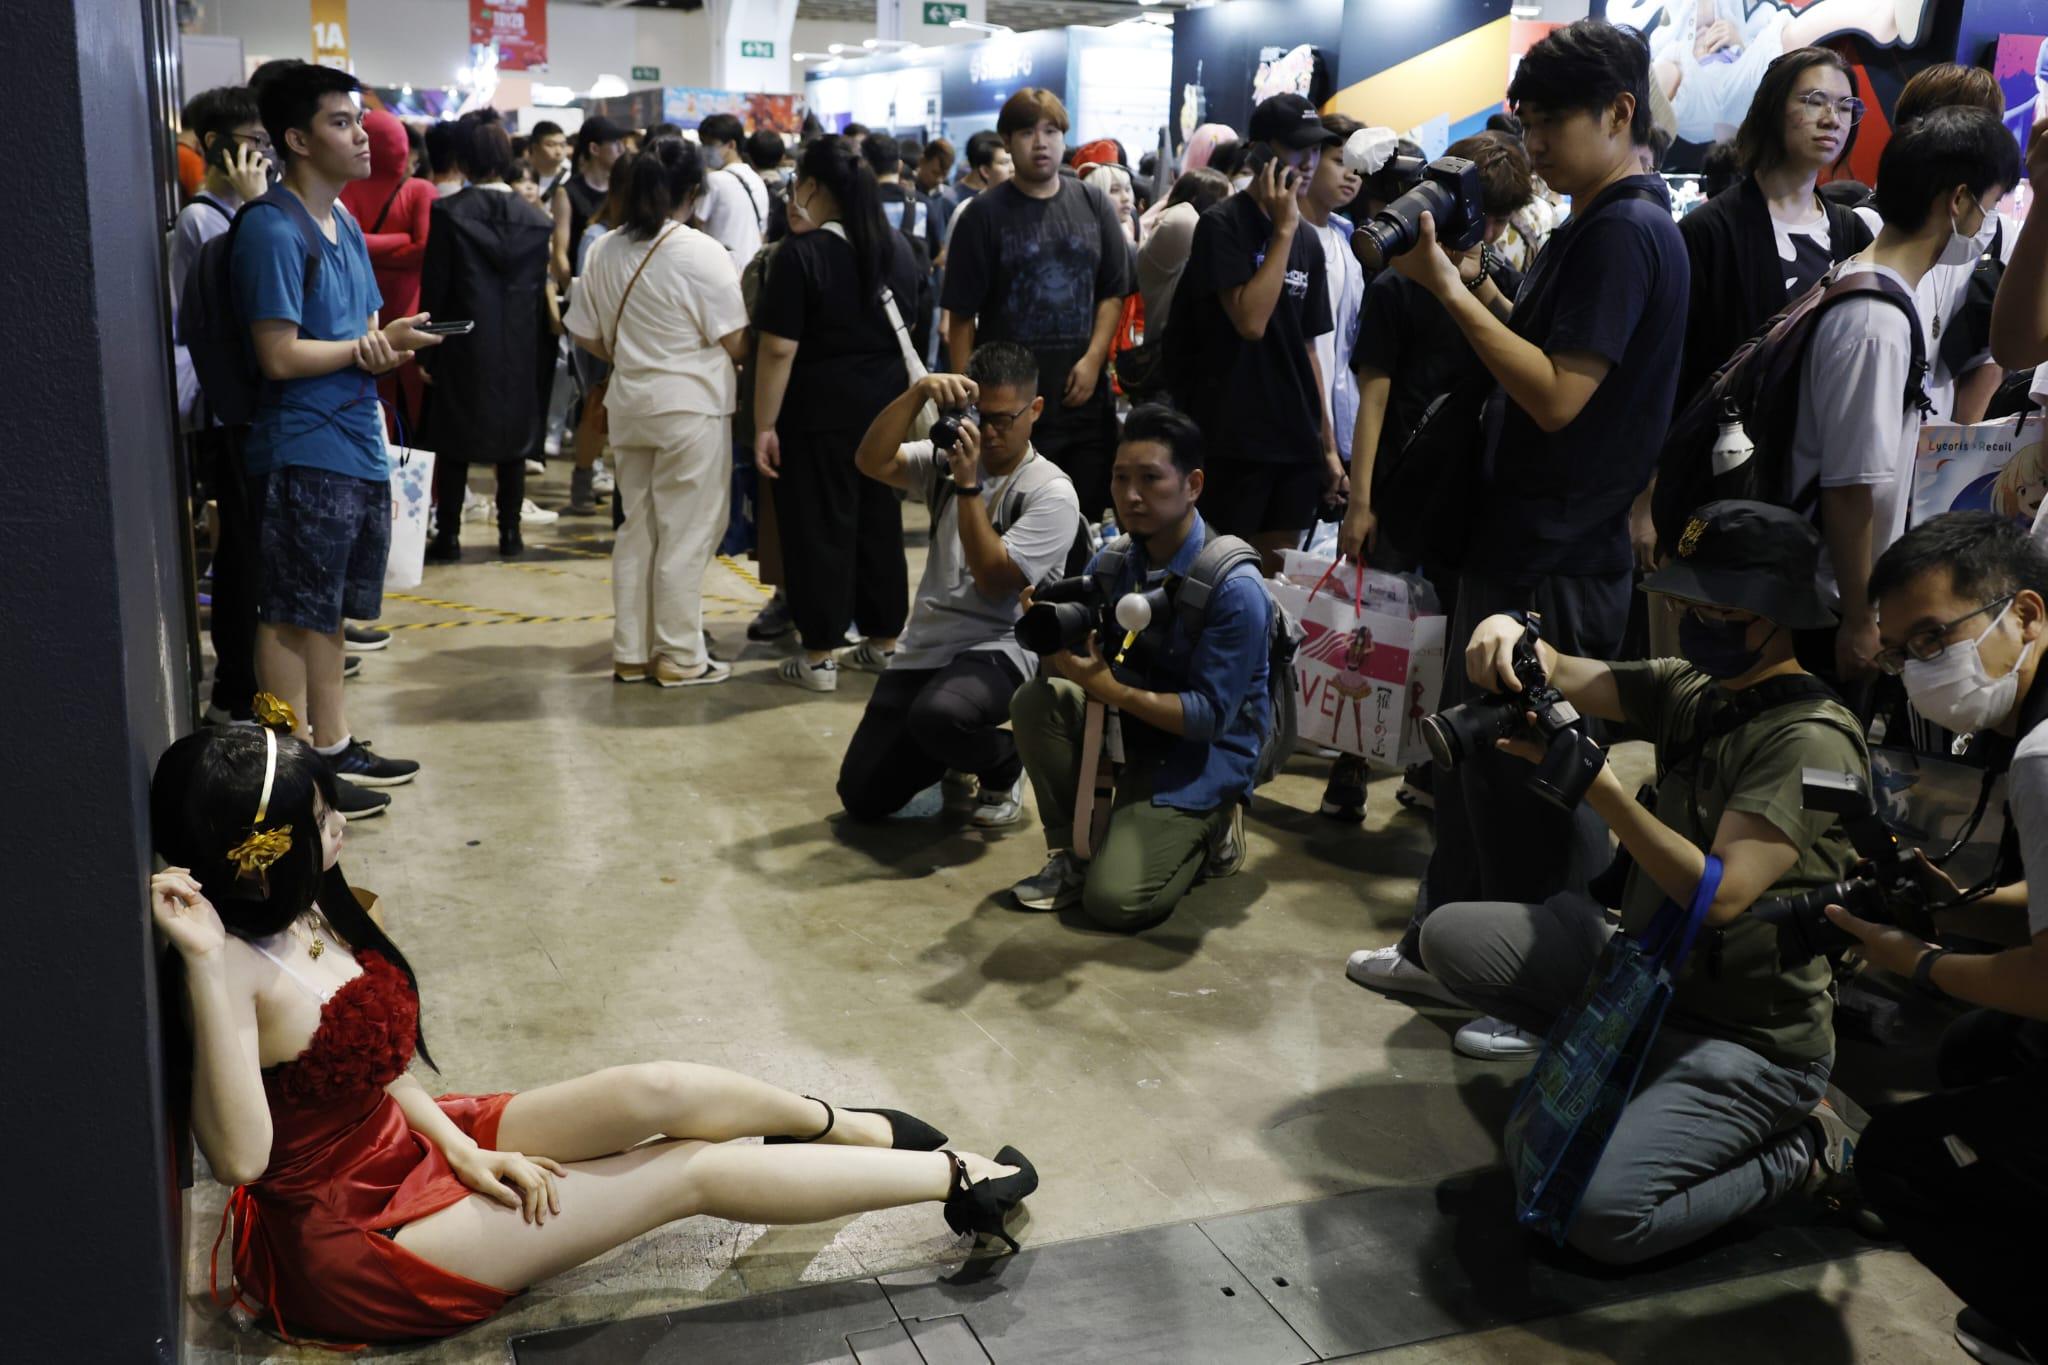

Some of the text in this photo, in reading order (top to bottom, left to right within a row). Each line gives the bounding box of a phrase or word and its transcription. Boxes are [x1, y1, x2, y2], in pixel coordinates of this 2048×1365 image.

[313, 22, 346, 48] 1A
[1928, 441, 2012, 453] Lycoris Recoil
